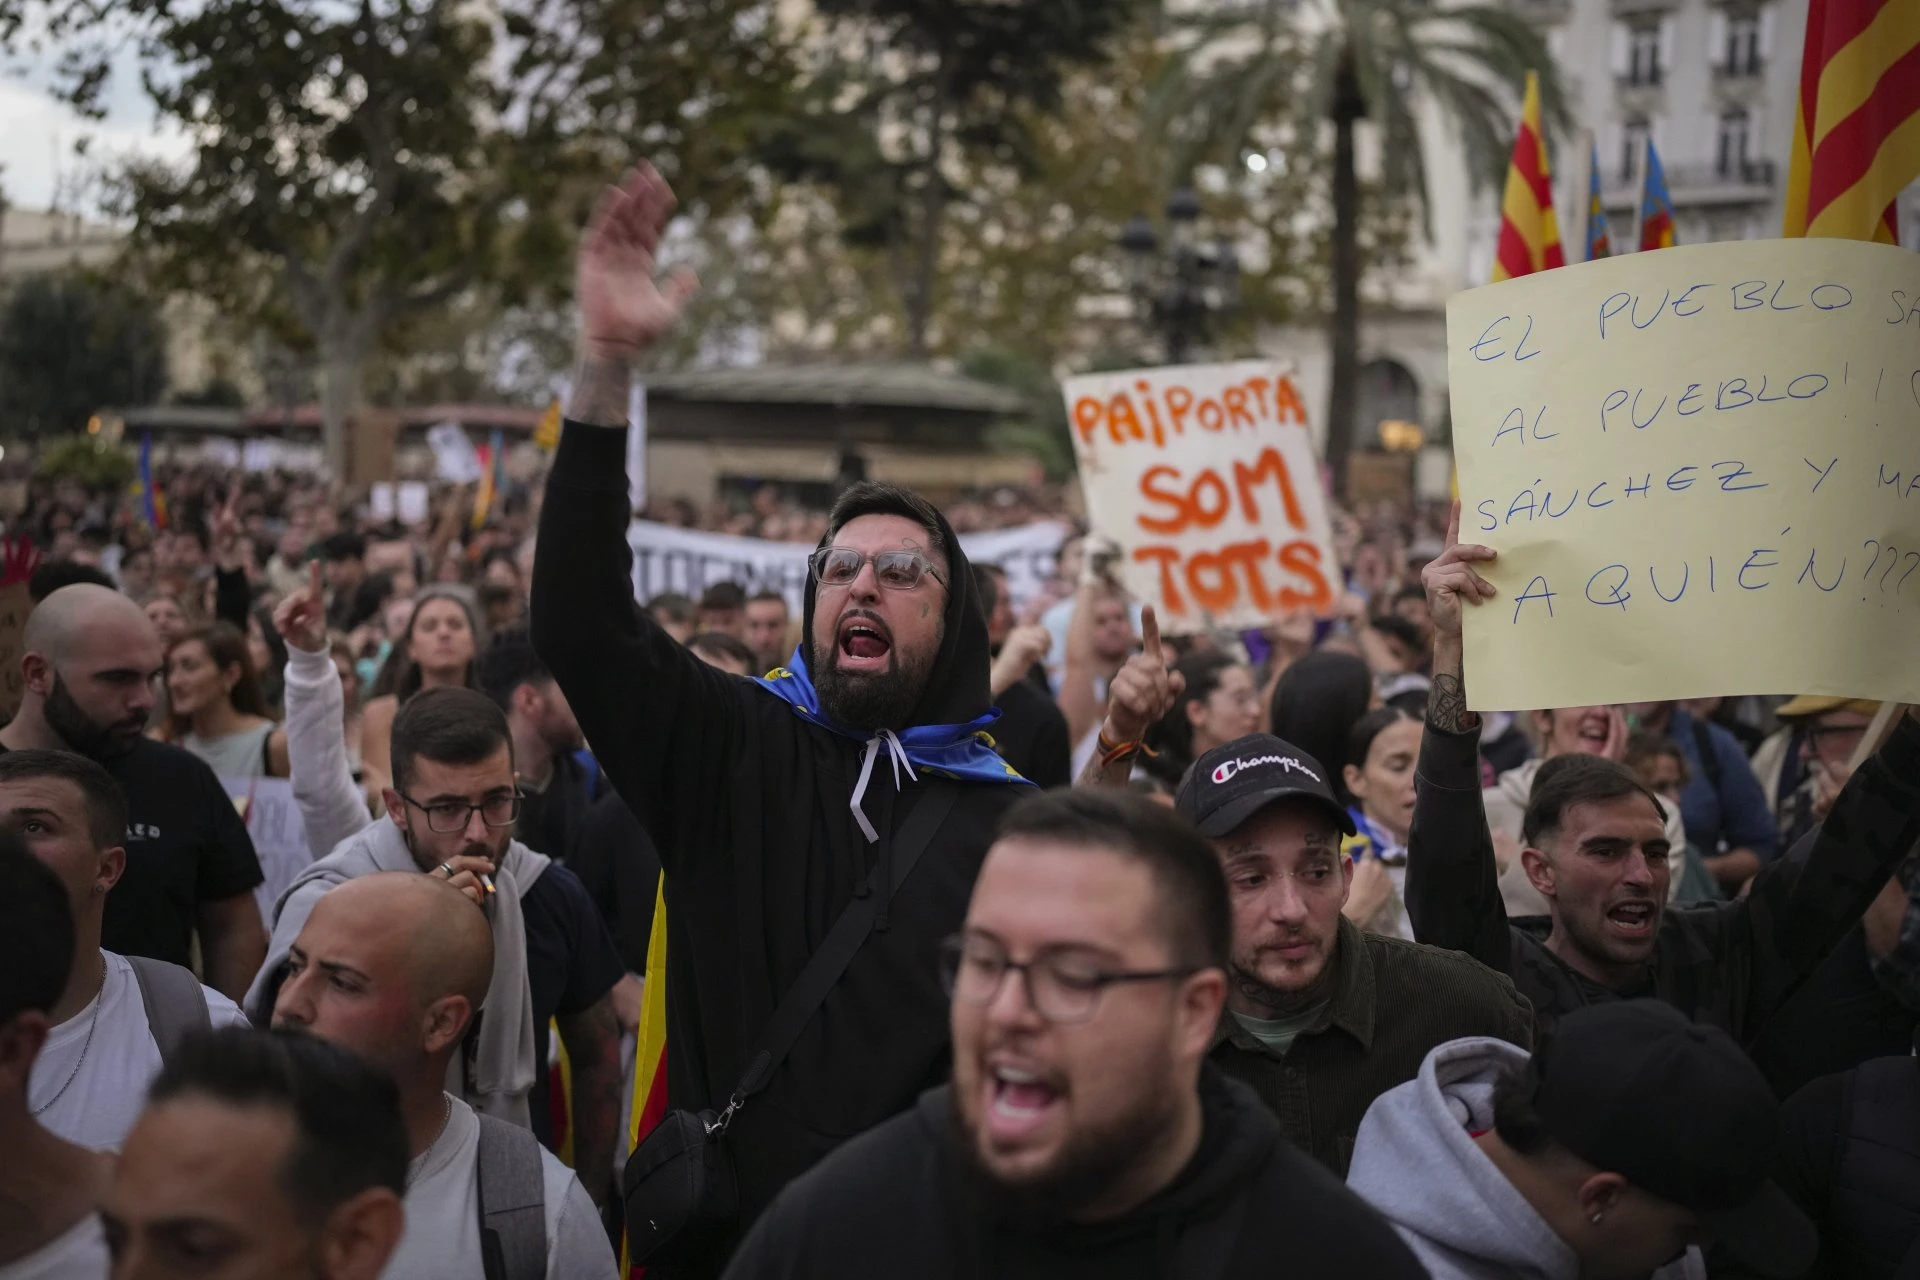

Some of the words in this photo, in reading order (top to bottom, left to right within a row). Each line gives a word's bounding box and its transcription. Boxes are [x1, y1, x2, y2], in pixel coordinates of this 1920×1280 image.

[1469, 315, 1541, 362] EL
[1599, 280, 1853, 340] PUEBLO
[1492, 406, 1560, 447] AL
[1136, 446, 1307, 536] SOM
[1476, 461, 1770, 531] SÁNCHEZ
[1803, 458, 1838, 493] Y
[1132, 537, 1334, 619] TOTS
[1513, 575, 1557, 625] A
[1211, 754, 1321, 785] Champion
